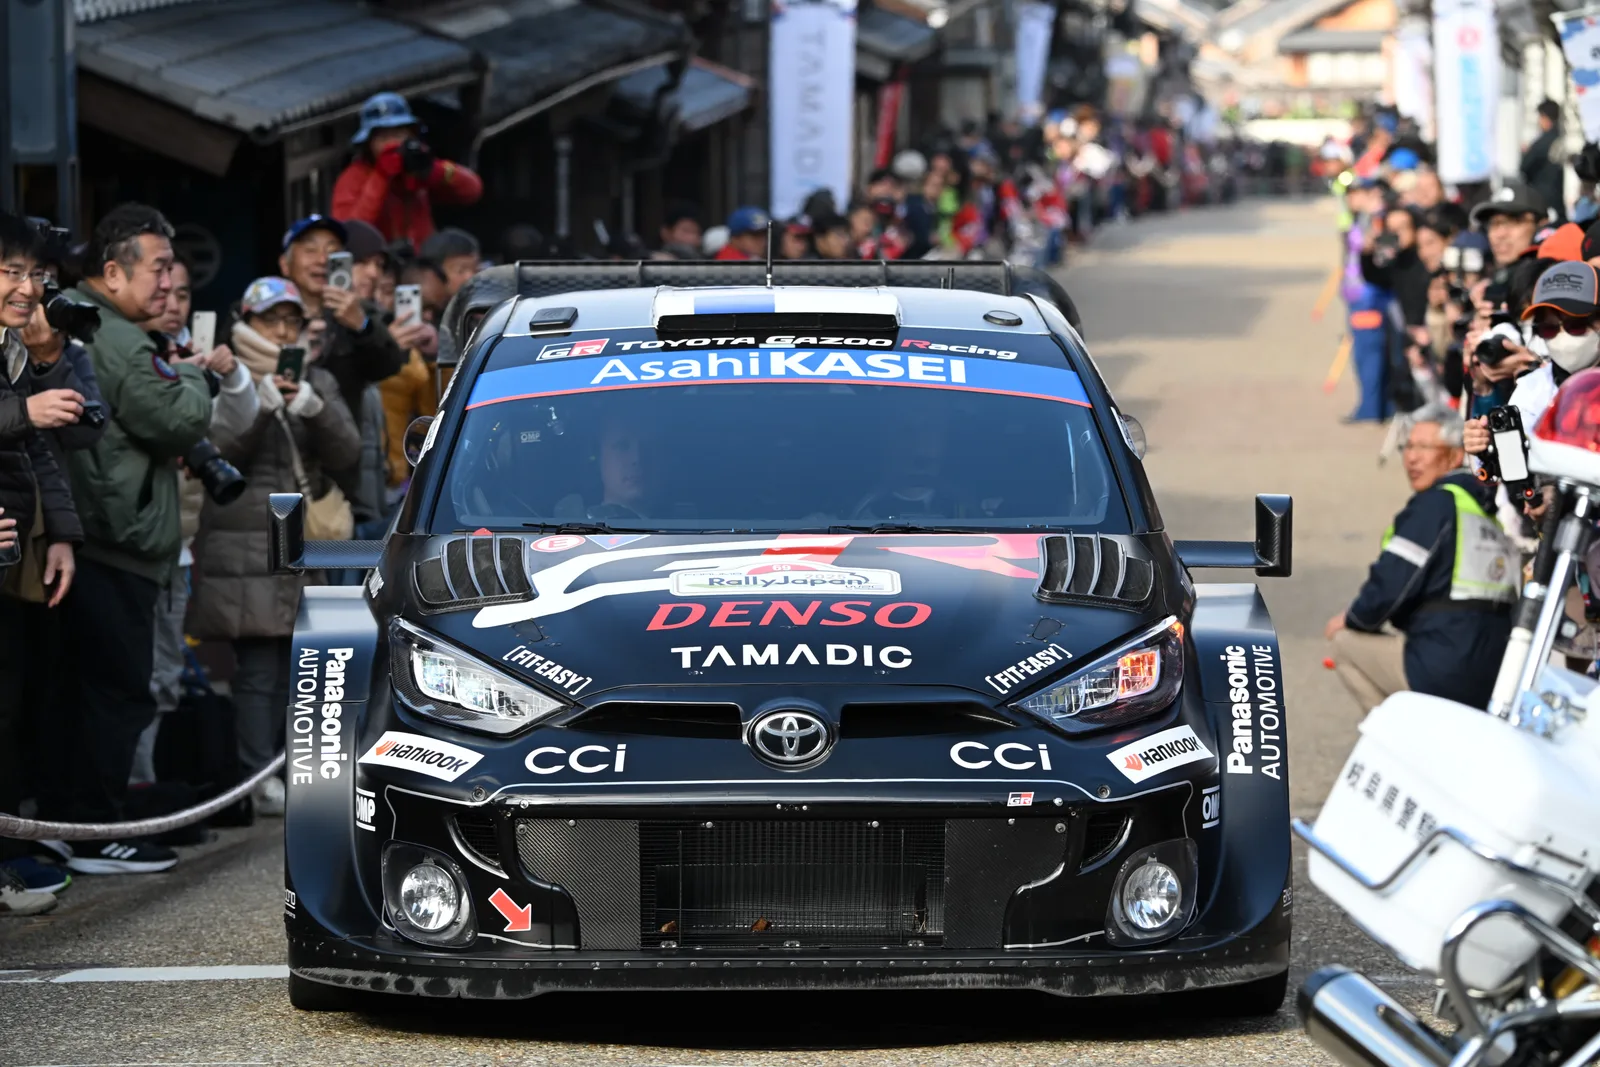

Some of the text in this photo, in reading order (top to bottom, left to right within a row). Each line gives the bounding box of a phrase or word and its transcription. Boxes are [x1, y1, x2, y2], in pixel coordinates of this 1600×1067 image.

[1542, 273, 1583, 287] WRC
[540, 342, 604, 360] GR
[616, 335, 1018, 360] TOYOTA GAZOO Racing
[521, 432, 541, 442] OMP
[646, 601, 932, 630] DENSO
[671, 643, 912, 668] TAMADIC
[293, 647, 319, 785] AUTOMOTIVE
[320, 647, 353, 779] Panasonic
[1220, 645, 1253, 774] Panasonic
[1252, 645, 1280, 780] AUTOMOTIVE
[356, 794, 376, 823] OMP
[1008, 795, 1032, 805] GR
[1202, 792, 1220, 821] OM
